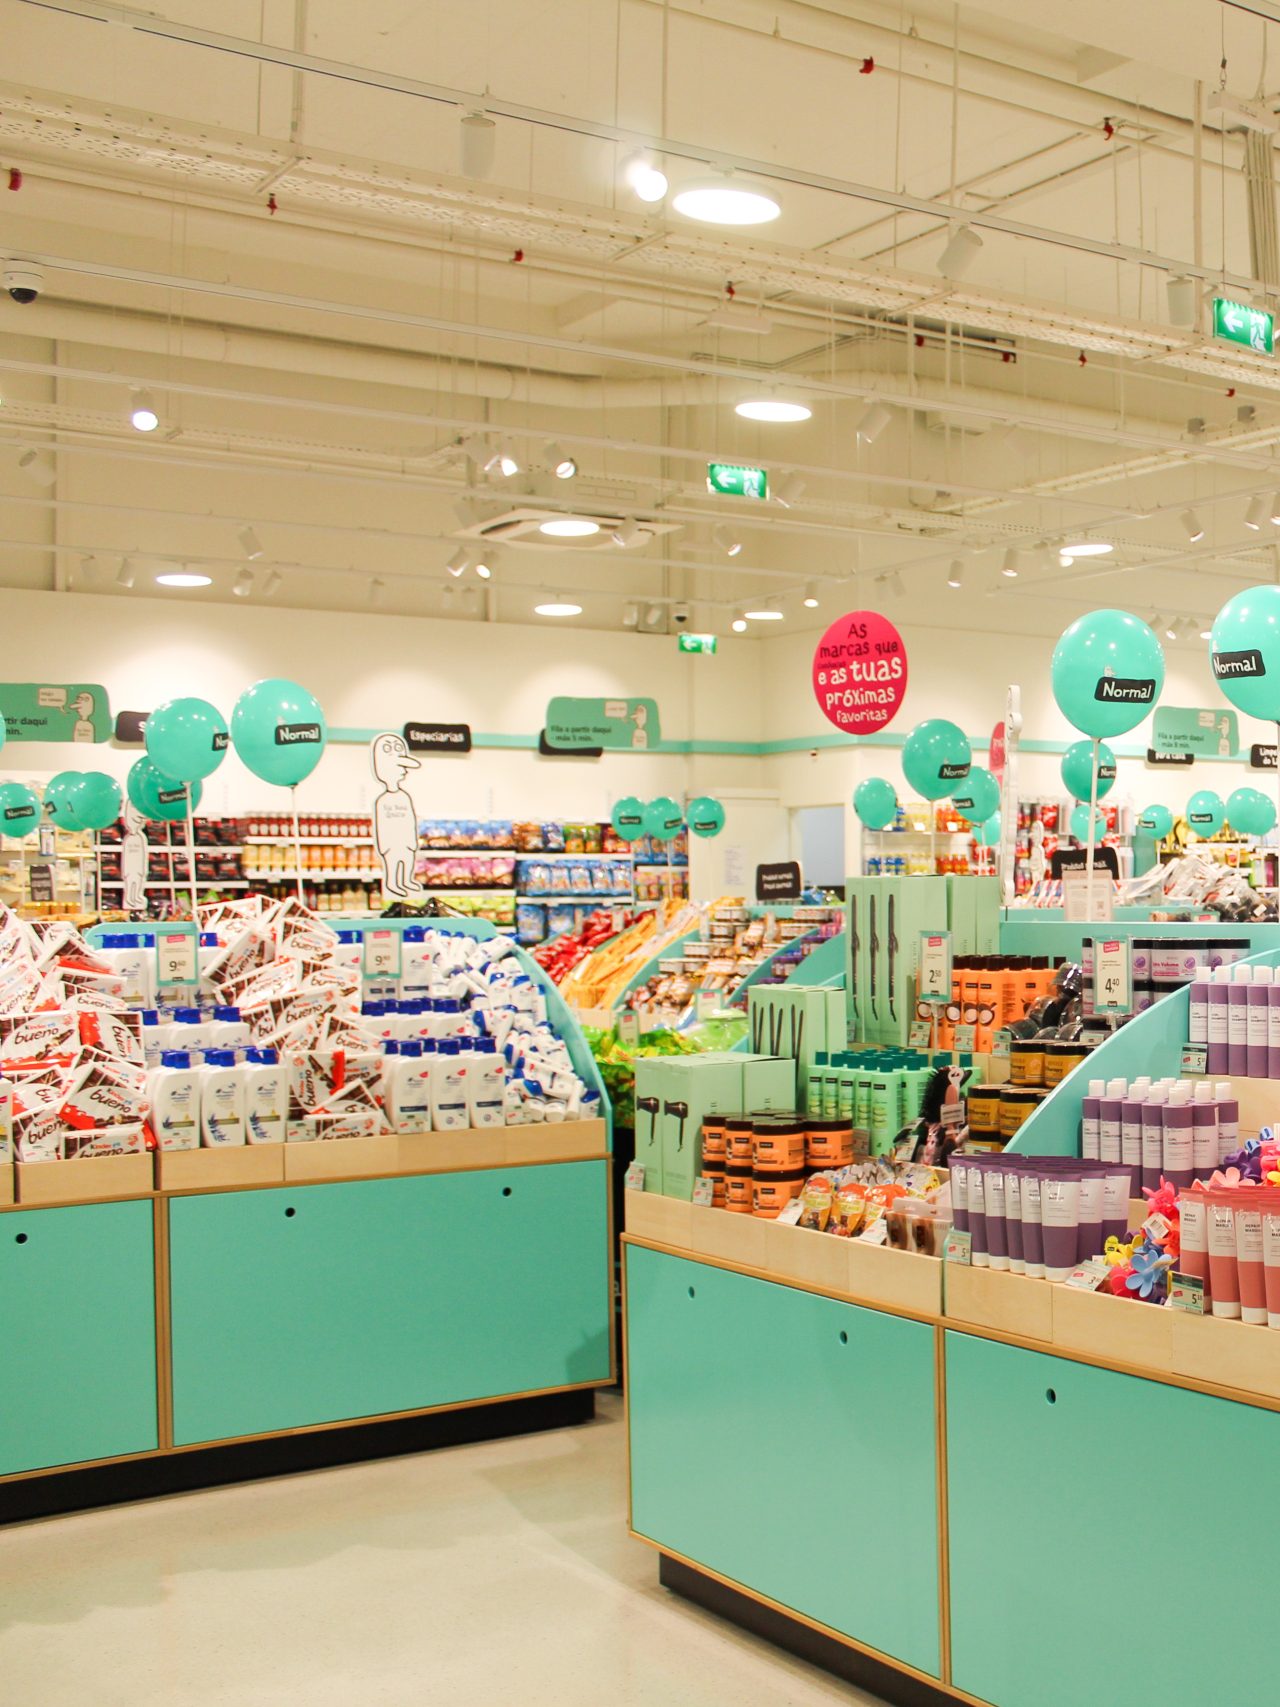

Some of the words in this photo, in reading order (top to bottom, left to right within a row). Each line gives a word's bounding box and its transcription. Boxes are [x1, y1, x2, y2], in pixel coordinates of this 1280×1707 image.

[820, 641, 870, 658] marcas
[875, 640, 899, 657] que
[818, 672, 827, 685] e
[830, 667, 848, 685] as
[850, 656, 903, 682] tuas
[1213, 655, 1257, 675] Normal
[826, 686, 896, 710] próximas
[1103, 682, 1152, 700] Normal
[836, 708, 888, 723] favoritas
[279, 726, 319, 742] Normal
[408, 729, 466, 743] Especiarias
[285, 1003, 323, 1023] bueno
[14, 1028, 59, 1045] bueno
[90, 1088, 131, 1113] bueno
